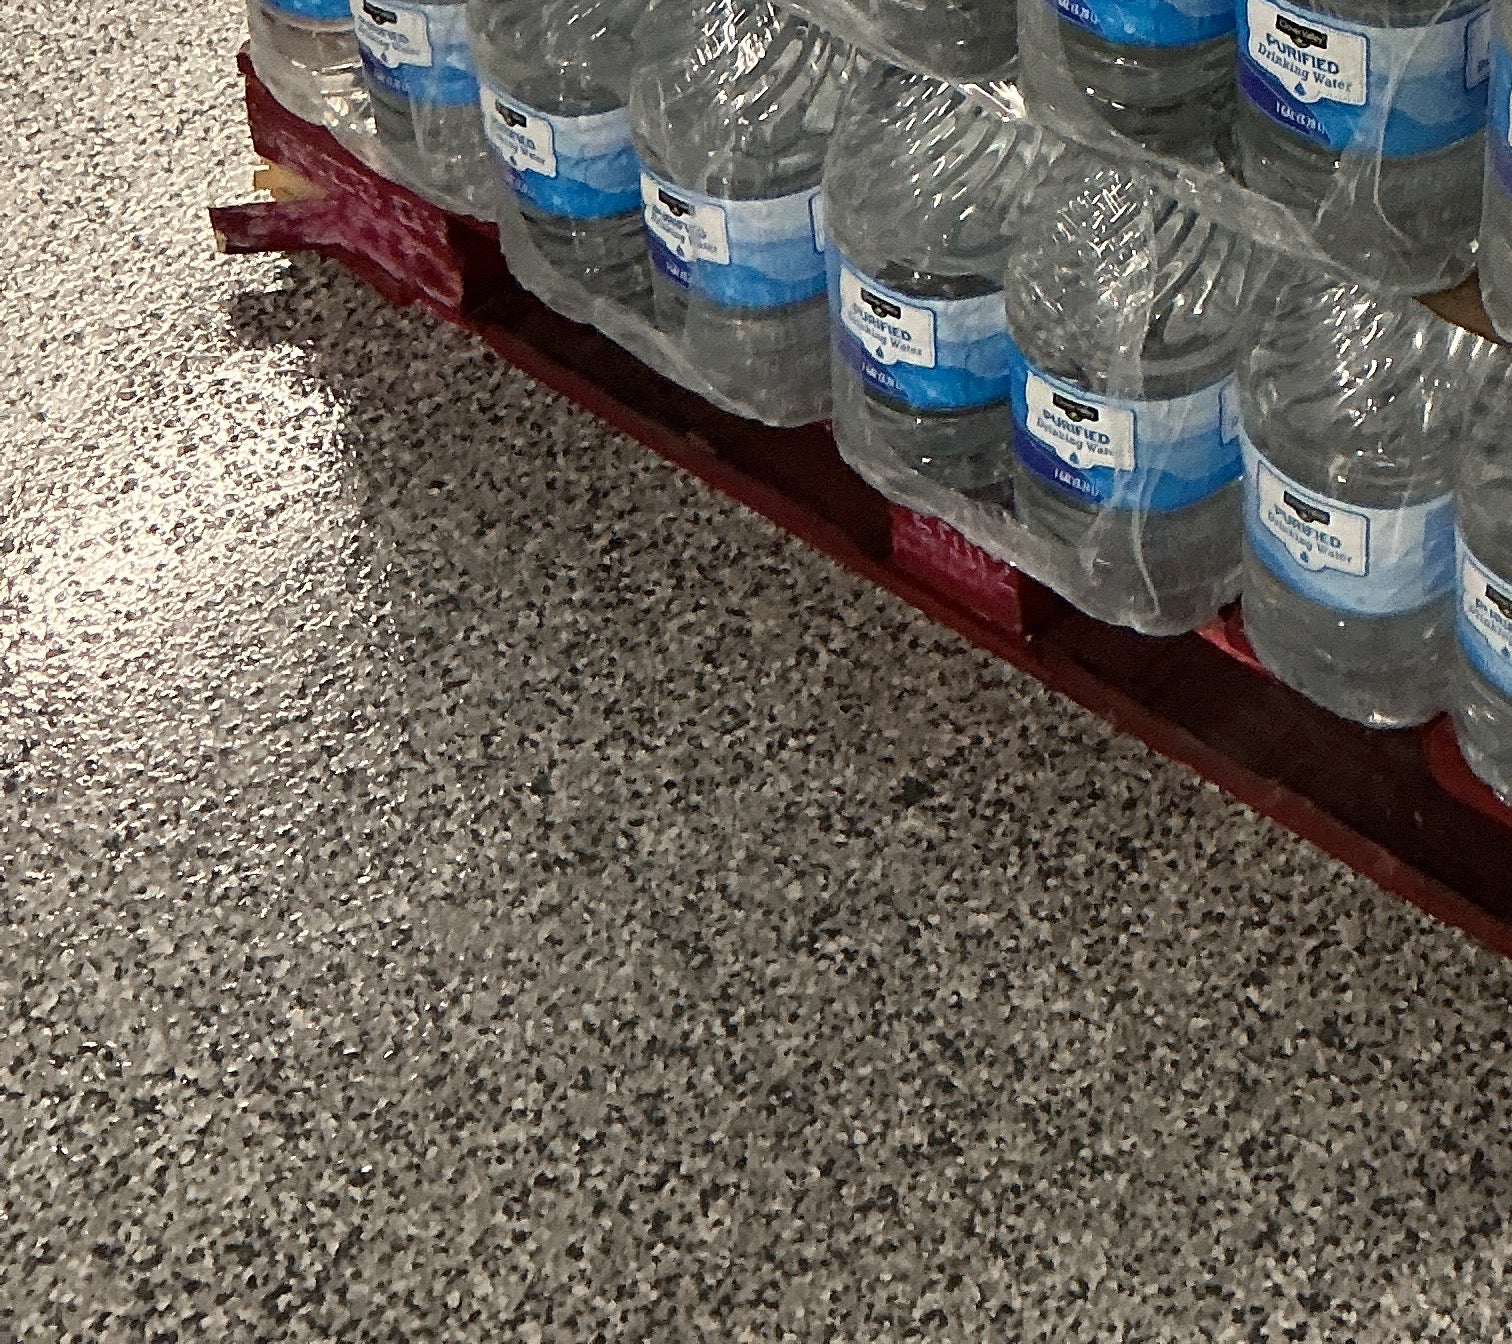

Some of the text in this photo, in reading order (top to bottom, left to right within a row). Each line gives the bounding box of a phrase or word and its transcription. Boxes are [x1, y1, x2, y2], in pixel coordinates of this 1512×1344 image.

[1258, 42, 1353, 93] Drinking Water
[1266, 32, 1340, 75] PURIFIED
[1043, 408, 1110, 445] PURIFIED
